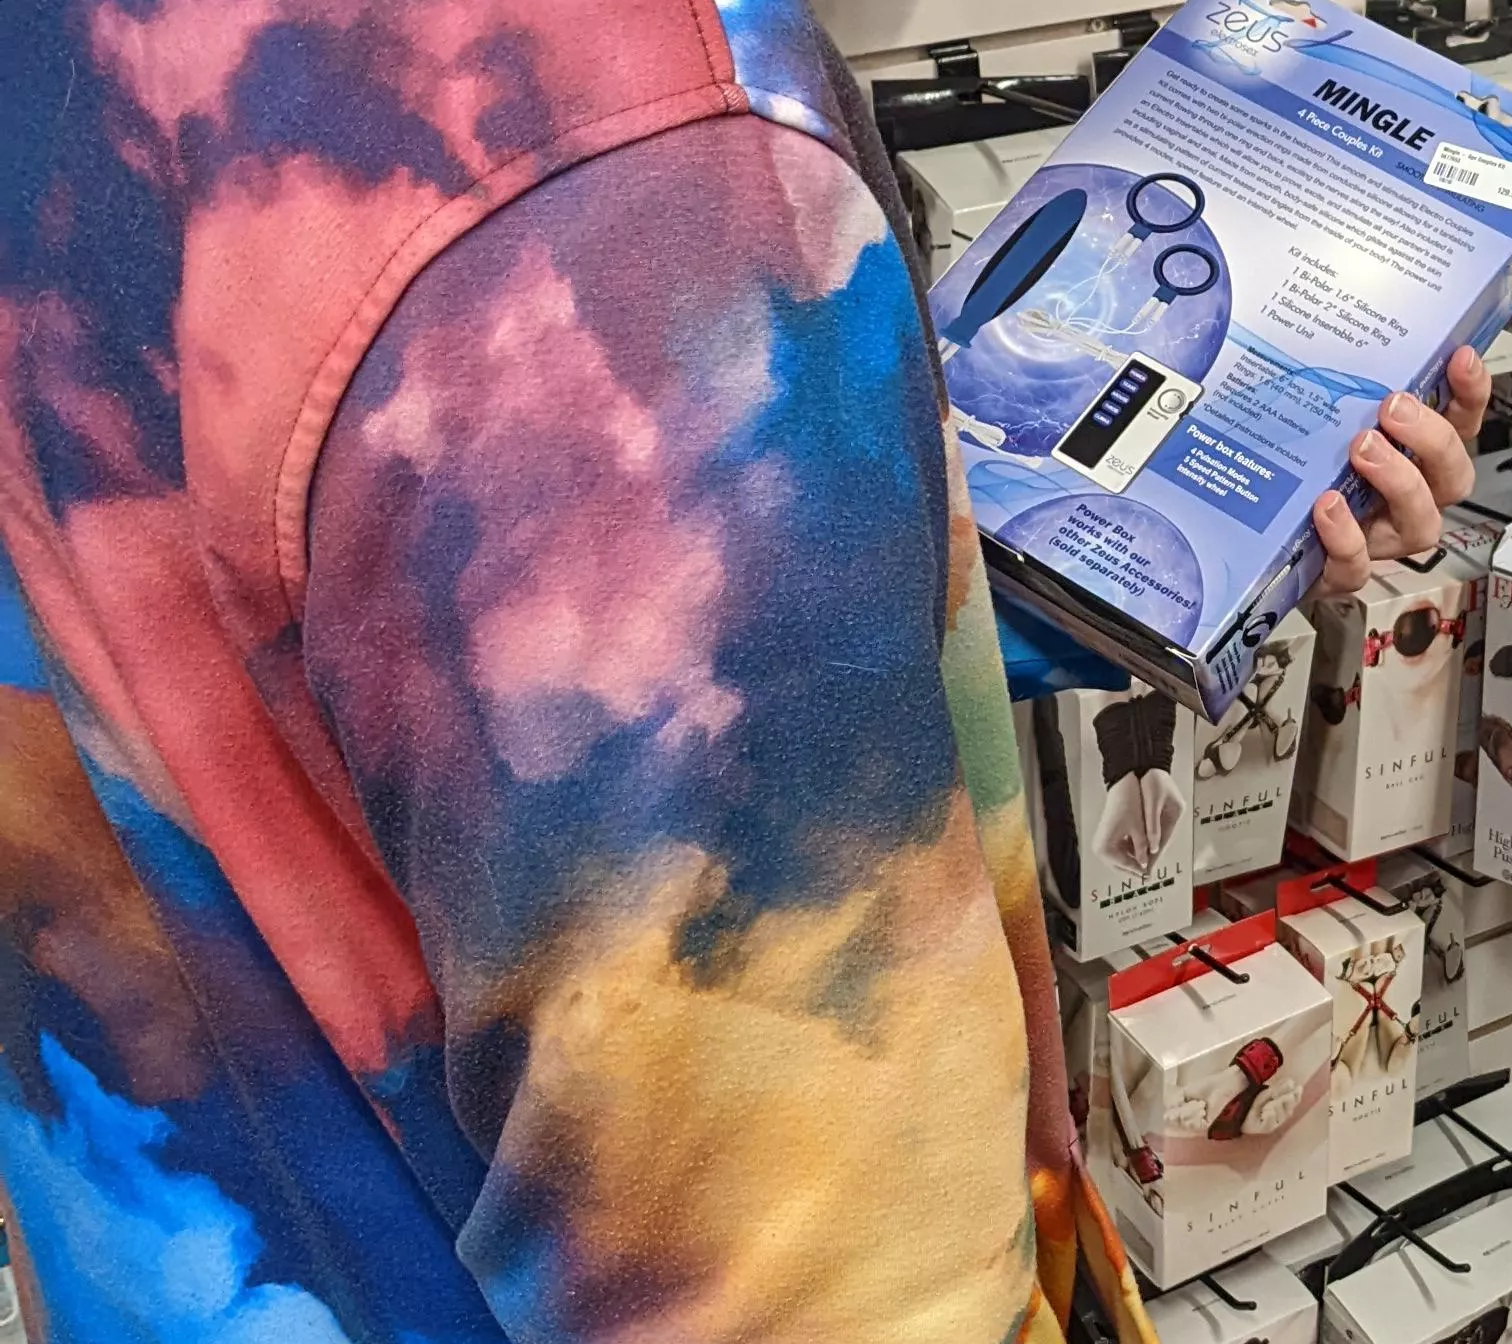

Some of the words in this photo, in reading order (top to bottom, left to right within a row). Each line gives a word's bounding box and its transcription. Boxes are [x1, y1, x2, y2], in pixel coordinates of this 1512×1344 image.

[1305, 111, 1330, 130] Piece
[1331, 125, 1367, 150] Couples
[1368, 145, 1383, 157] Kit
[1314, 80, 1433, 149] MINGLE
[1288, 246, 1301, 257] Kit
[1301, 253, 1336, 277] includes:
[1267, 309, 1295, 328] Power
[1295, 324, 1314, 339] Unit
[1278, 296, 1311, 319] Silicone
[1312, 314, 1354, 342] Insertable
[1288, 283, 1322, 305] Bi-Polar
[1336, 309, 1369, 332] Silicone
[1370, 327, 1390, 346] Ring
[1299, 270, 1332, 292] Bi-Polar
[1353, 299, 1386, 322] Silicone
[1387, 318, 1408, 337] Ring
[1212, 390, 1229, 401] (not
[1228, 399, 1261, 420] included)
[1220, 381, 1252, 403] Requires
[1258, 403, 1277, 416] AAA
[1277, 413, 1309, 435] batteries
[1322, 401, 1340, 413] wide
[1105, 454, 1134, 474] zeus
[1186, 424, 1216, 445] Power
[1217, 441, 1234, 457] box
[1234, 451, 1274, 479] features:
[1233, 422, 1274, 448] instructions
[1274, 446, 1307, 466] included
[1176, 463, 1206, 485] Intensity
[1206, 481, 1227, 496] wheel
[1188, 458, 1211, 474] Speed
[1210, 470, 1235, 488] Pattern
[1235, 485, 1258, 502] Button
[1195, 449, 1227, 471] Pulsation
[1226, 467, 1249, 484] Modes
[1067, 515, 1101, 538] works
[1103, 536, 1128, 554] with
[1129, 552, 1150, 566] our
[1075, 503, 1112, 527] Power
[1112, 524, 1135, 542] Box
[1048, 536, 1079, 556] (sold
[1079, 554, 1144, 596] separately)
[1058, 526, 1090, 546] other
[1090, 544, 1119, 565] Zeus
[1120, 563, 1197, 609] Accessories!
[1365, 746, 1448, 780] SINFUL
[1193, 786, 1284, 820] SINFUL
[1090, 861, 1184, 903] SINFUL
[1328, 1078, 1409, 1118] SINFUL
[1186, 1170, 1305, 1234] SINFUL
